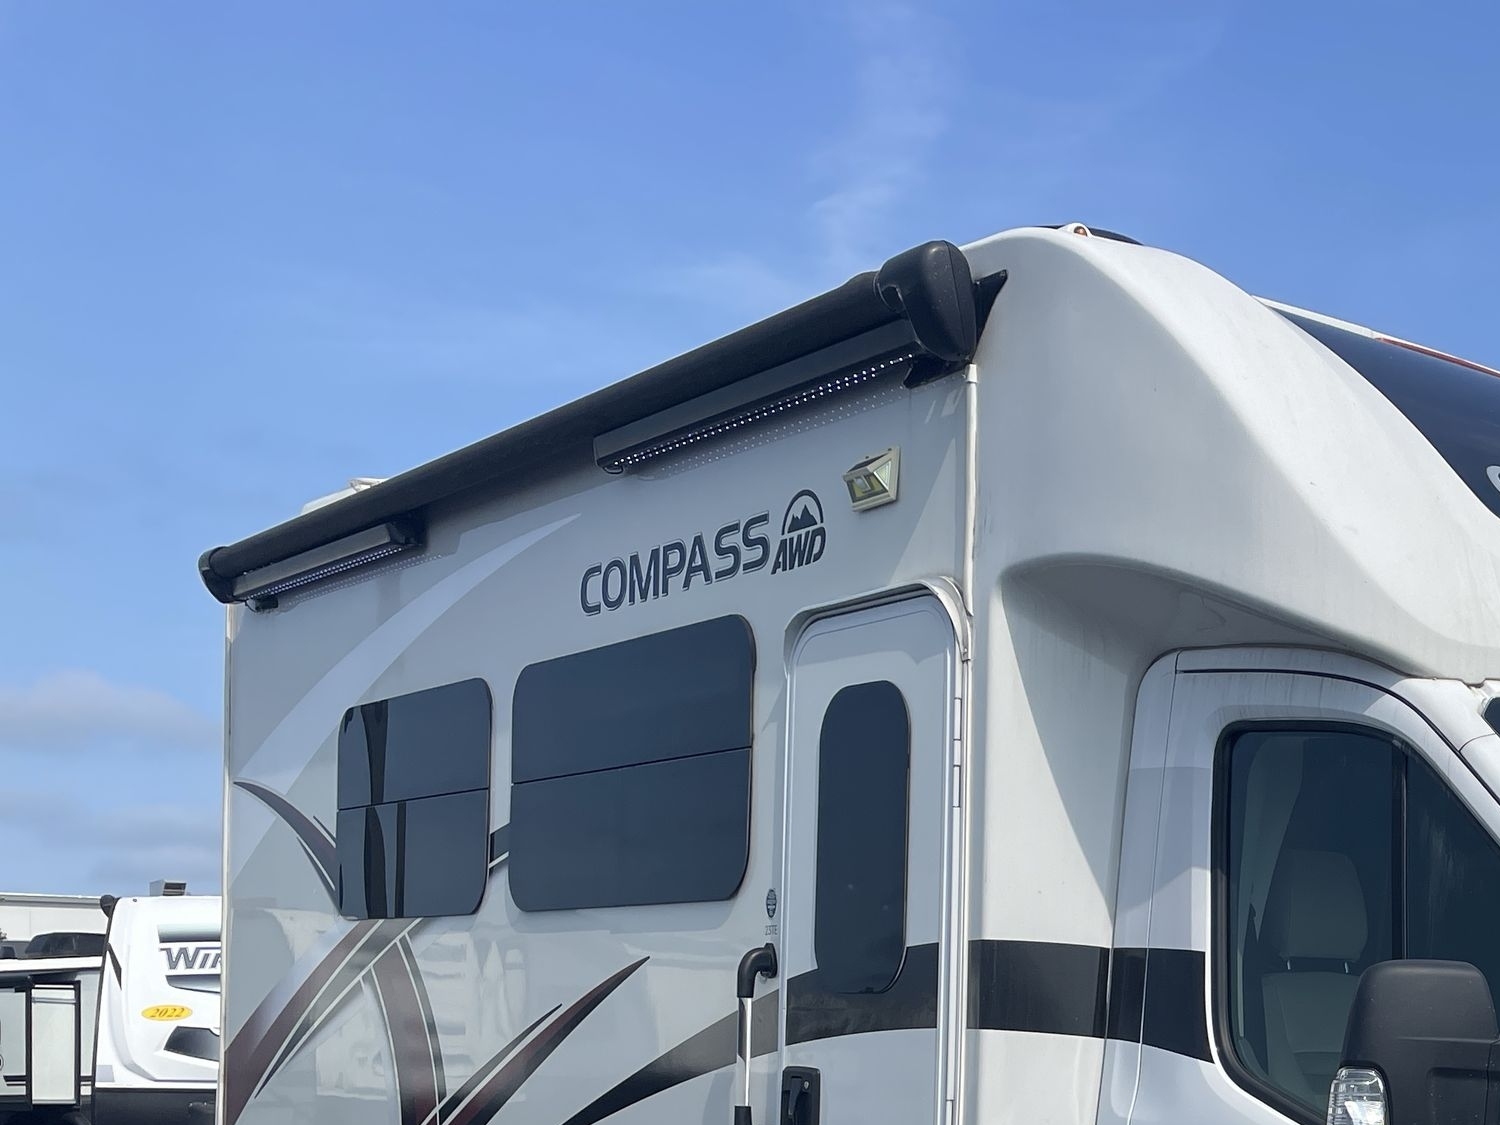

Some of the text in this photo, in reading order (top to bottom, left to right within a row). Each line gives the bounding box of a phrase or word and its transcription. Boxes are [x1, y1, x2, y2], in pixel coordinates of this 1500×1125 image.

[579, 510, 827, 617] COMPASS AWD
[149, 1007, 185, 1018] 2022
